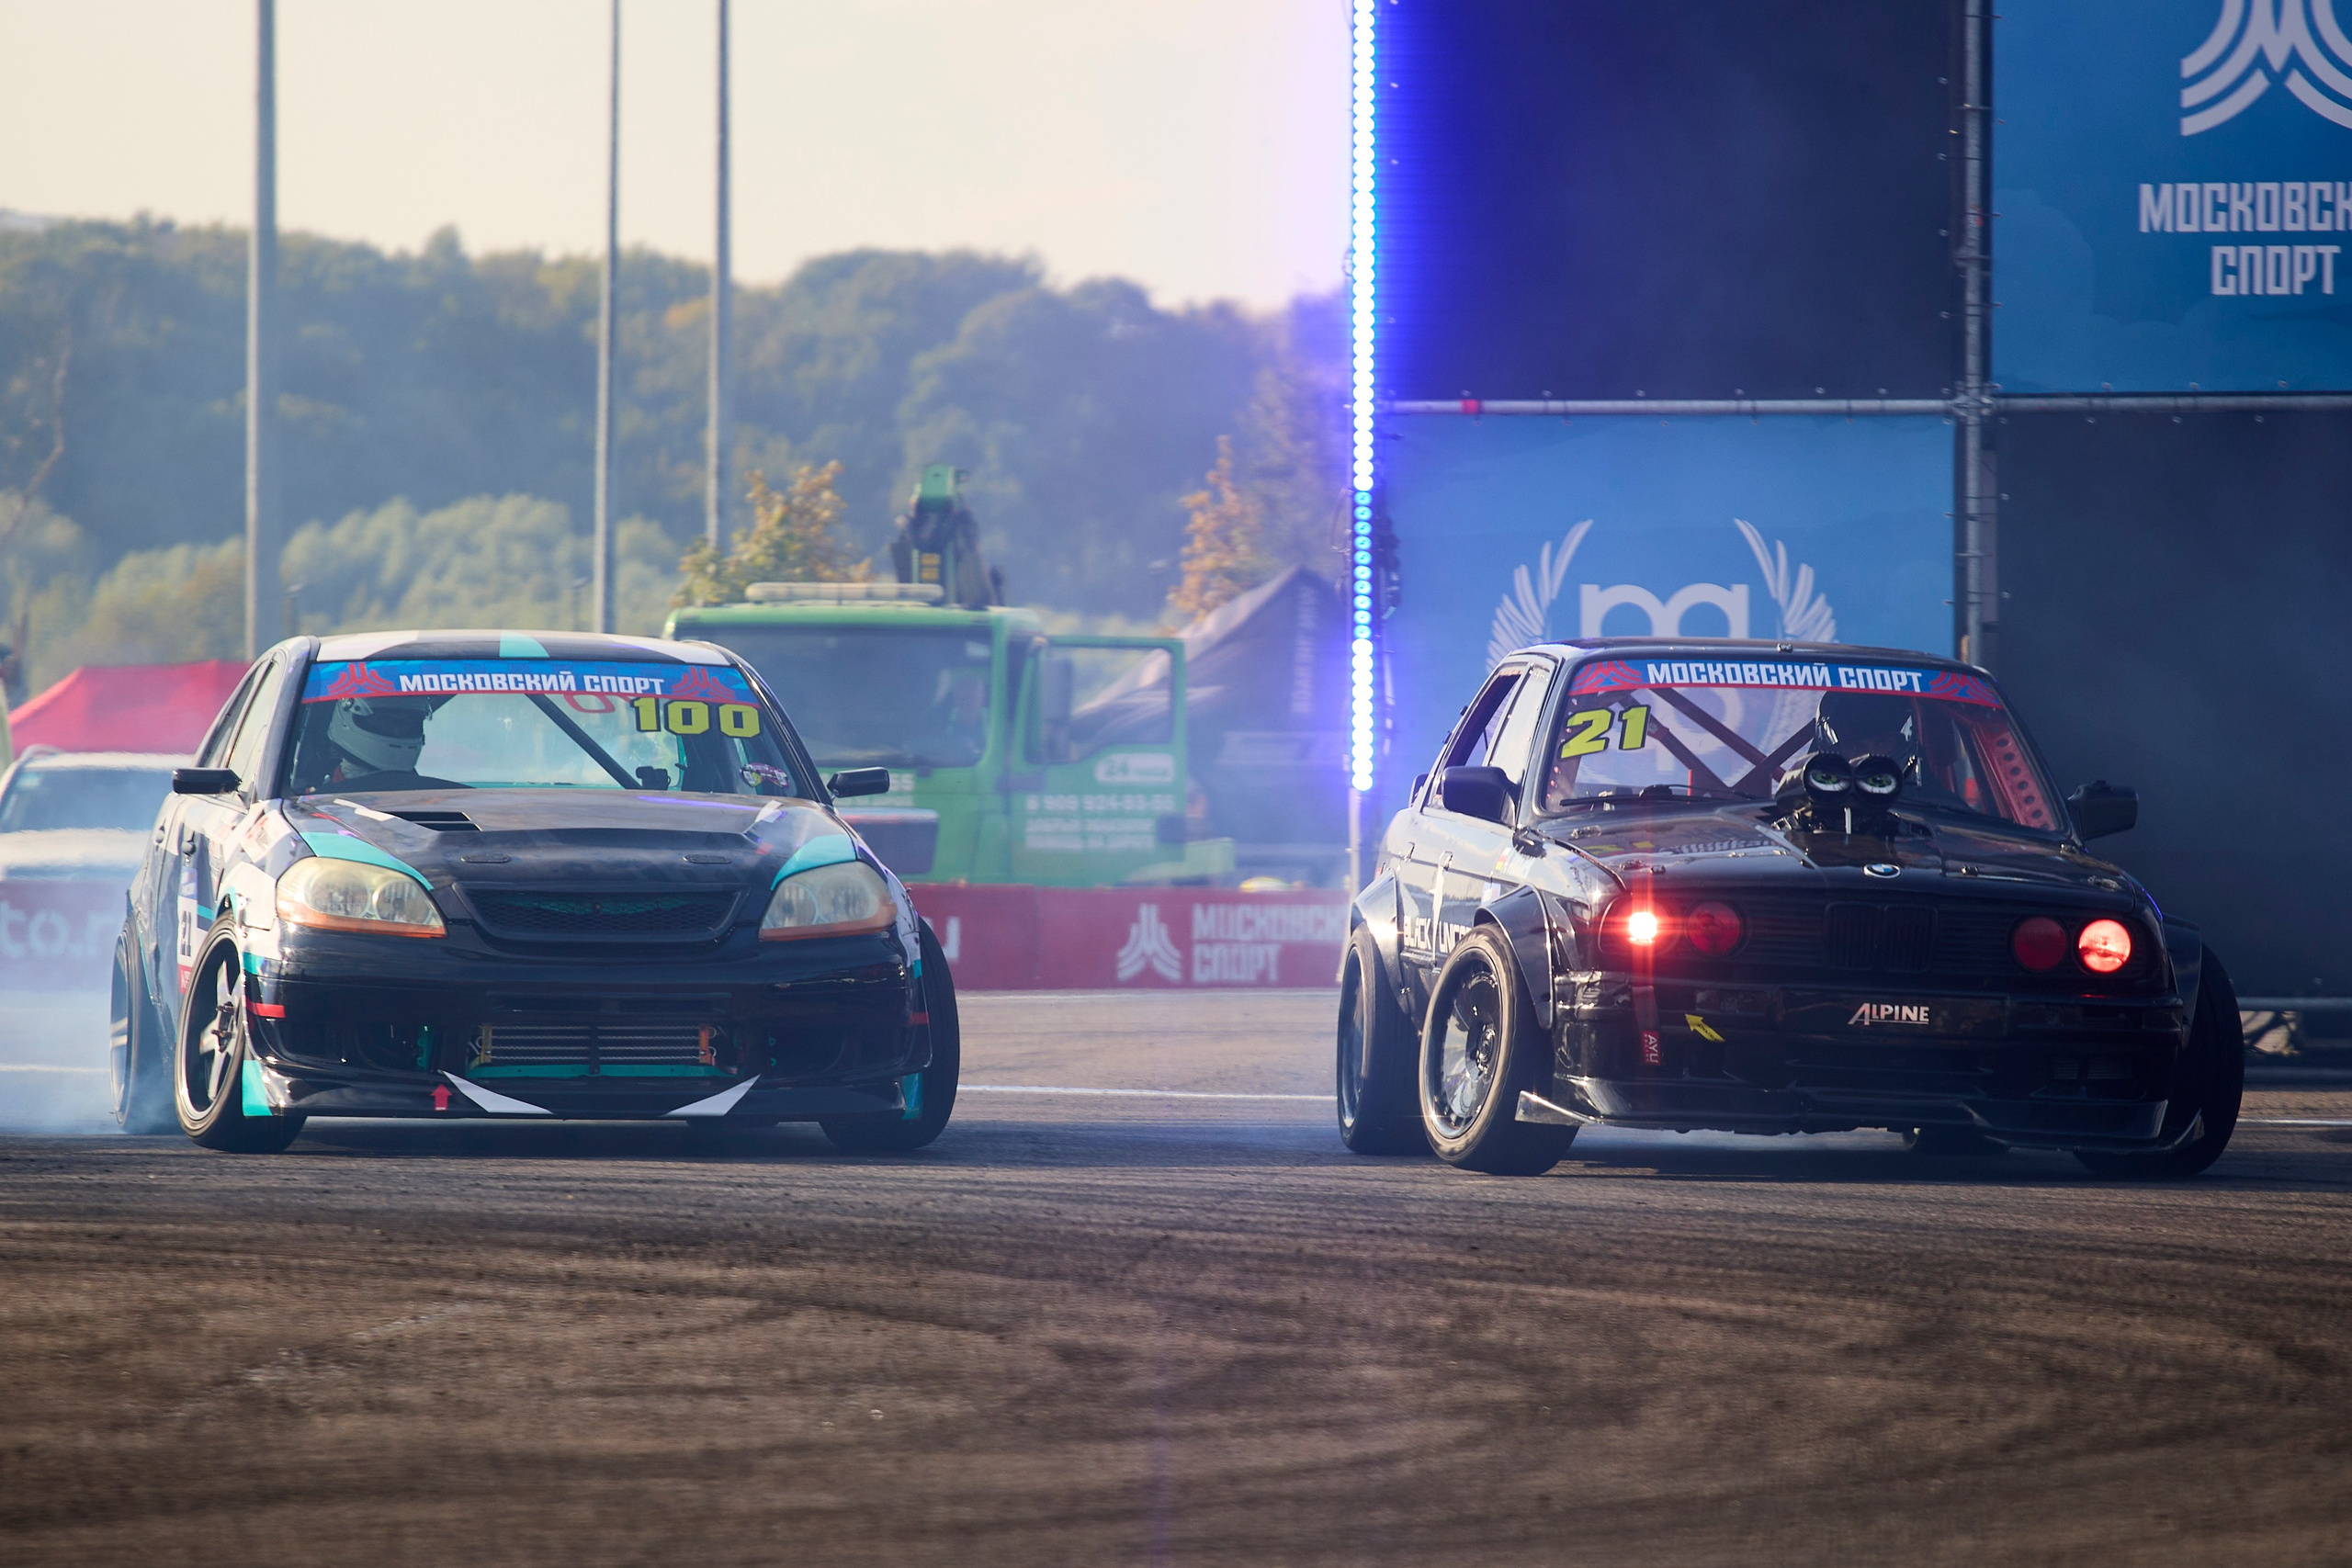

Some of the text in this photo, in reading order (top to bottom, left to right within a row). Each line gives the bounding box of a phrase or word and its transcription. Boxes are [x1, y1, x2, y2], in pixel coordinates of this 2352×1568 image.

[2211, 245, 2341, 295] СПОРТ
[399, 671, 664, 695] МОСКОВСКИЙ СПОРТ
[1647, 661, 1922, 693] МОСКОВСКИЙ СПОРТ
[631, 696, 762, 738] 100
[1561, 705, 1651, 759] 21
[1404, 915, 1431, 950] BLACK
[1848, 1002, 1929, 1025] ALPINE
[1647, 1034, 1659, 1064] AYU
